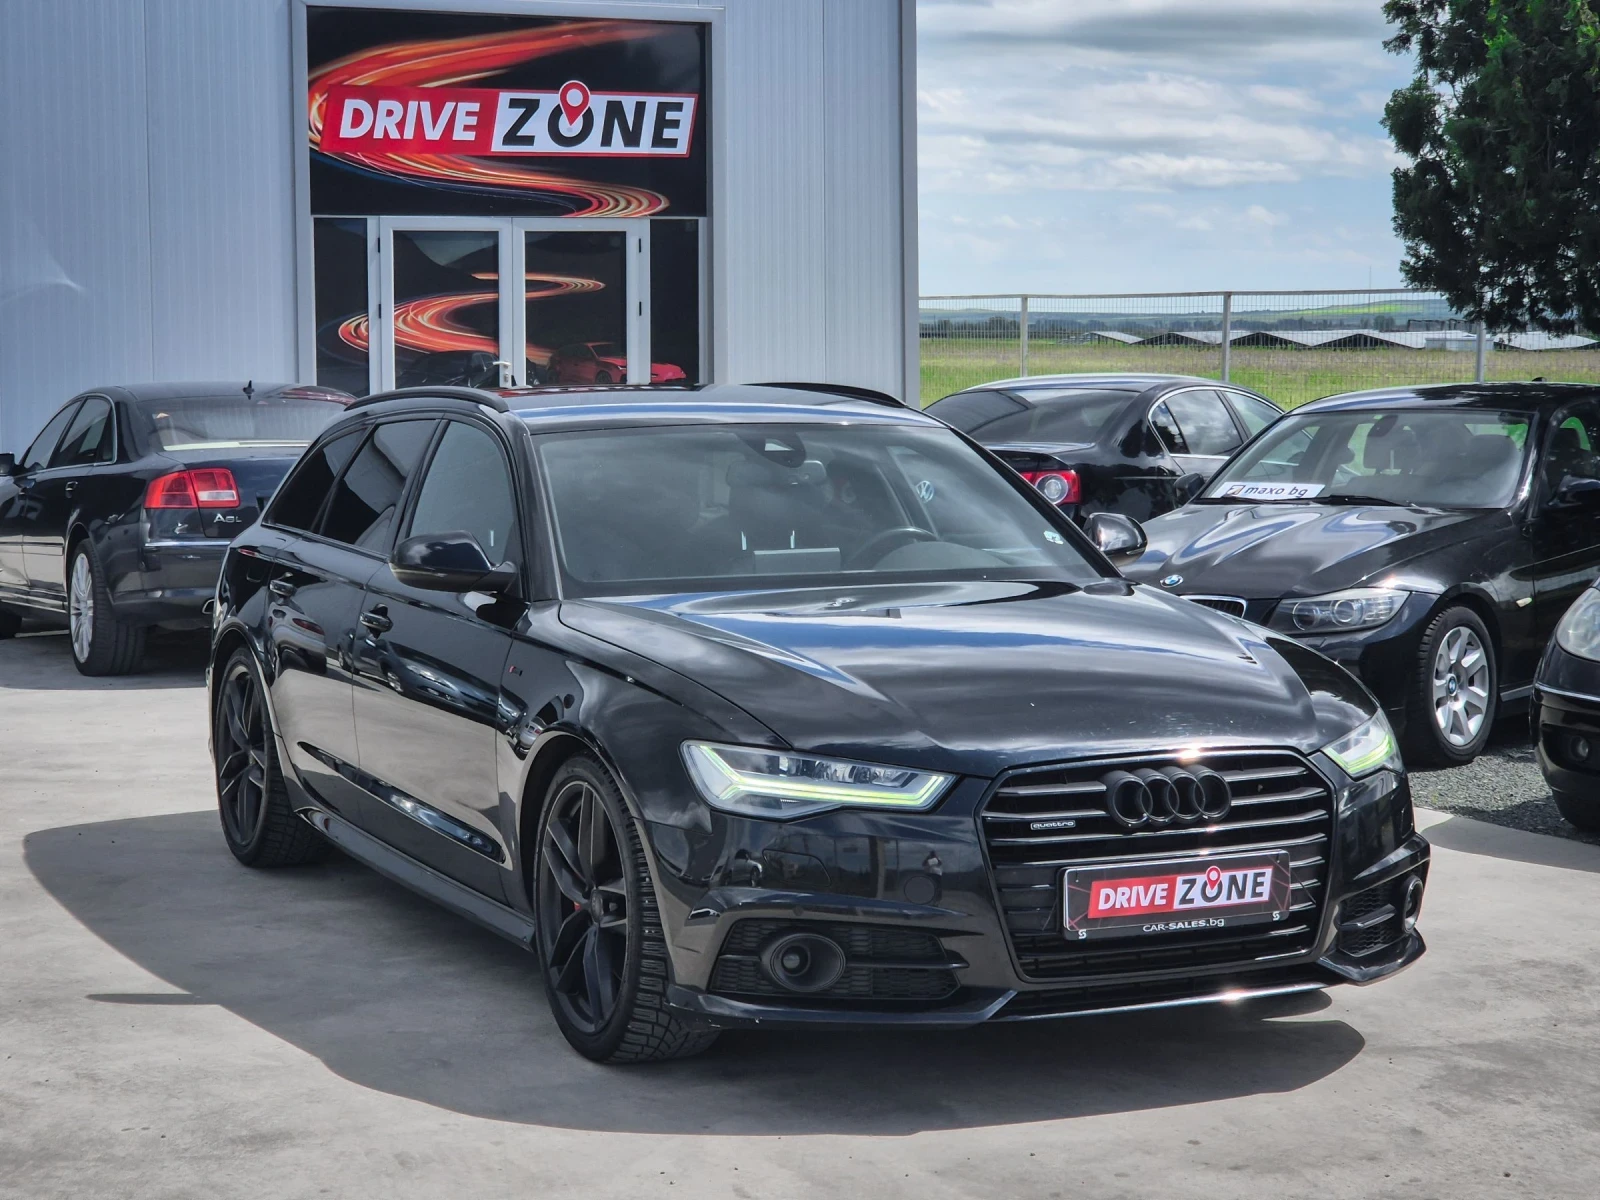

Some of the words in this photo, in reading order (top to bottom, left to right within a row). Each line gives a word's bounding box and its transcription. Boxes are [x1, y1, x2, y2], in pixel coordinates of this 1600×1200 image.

[338, 98, 481, 142] DRIVE
[501, 96, 684, 149] ZONE
[1033, 821, 1075, 830] quattro
[1097, 883, 1169, 911] DRIVE
[1178, 870, 1268, 905] ZONE
[1142, 917, 1226, 933] CAR-SALES.bg
